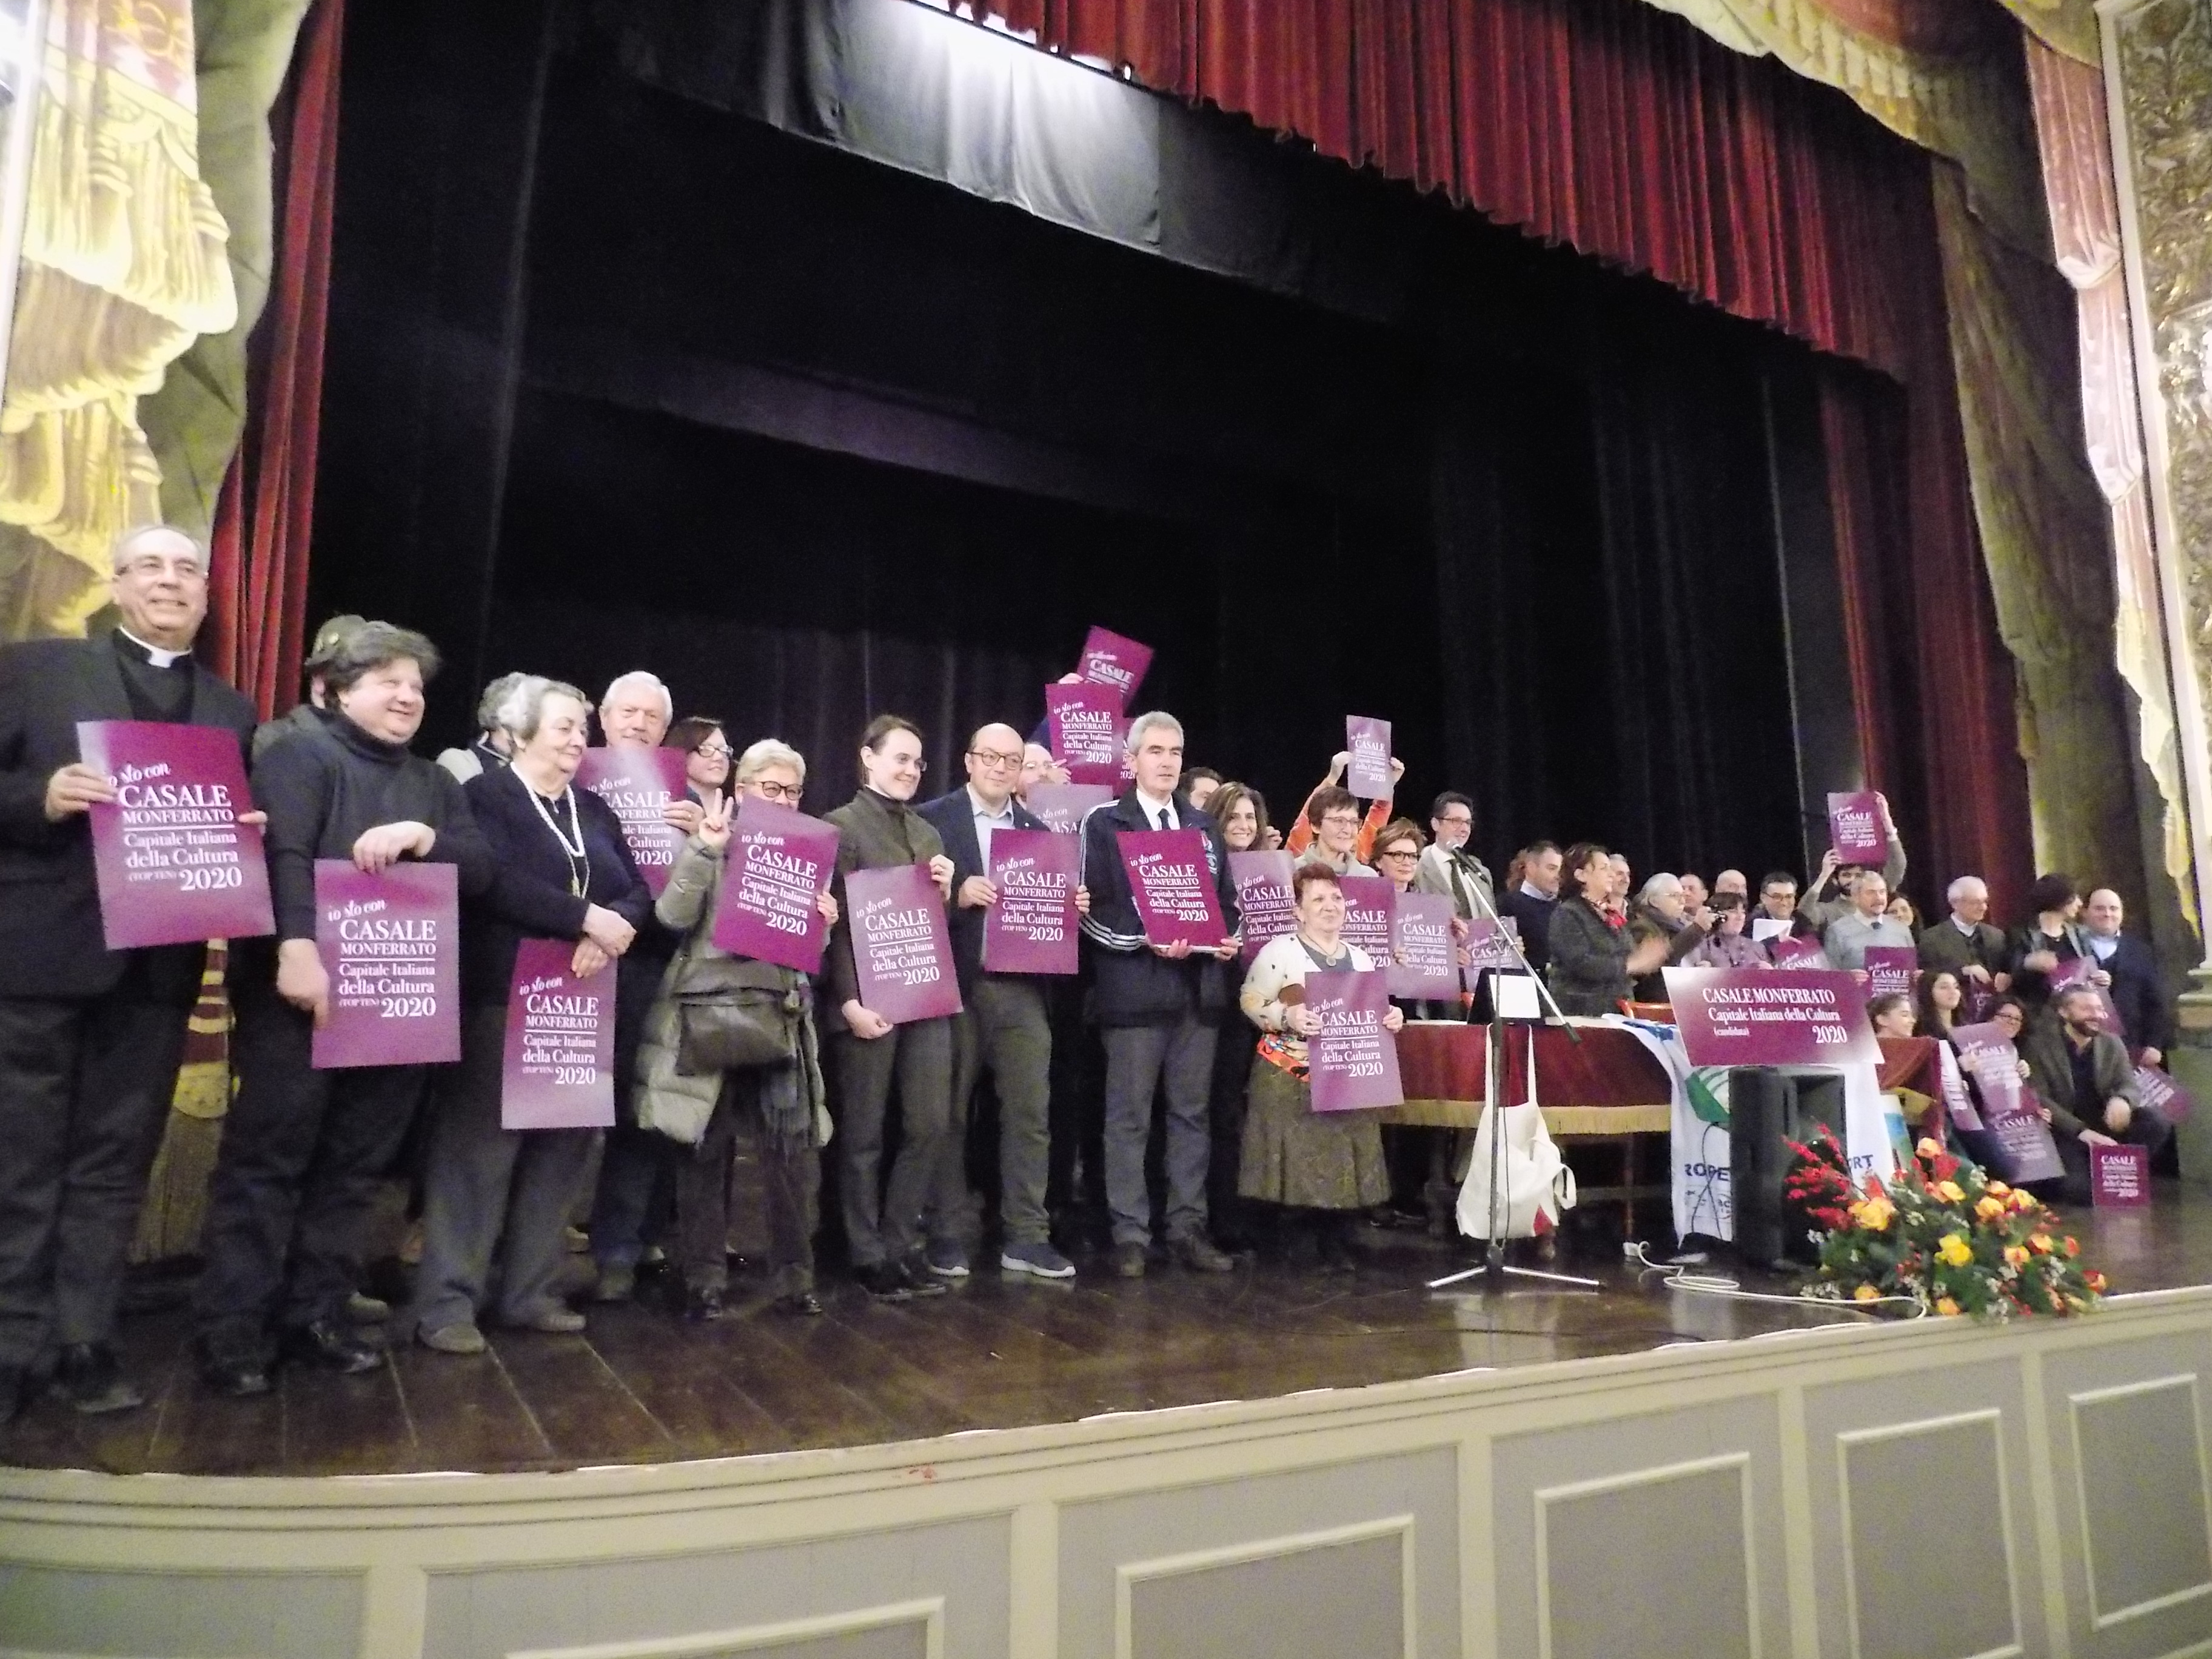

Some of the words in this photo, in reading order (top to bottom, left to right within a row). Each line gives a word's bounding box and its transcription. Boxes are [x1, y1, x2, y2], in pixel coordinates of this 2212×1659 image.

[1062, 702, 1071, 711] sto
[1061, 711, 1111, 723] CASALE
[1062, 733, 1089, 742] Capitale
[1084, 740, 1111, 751] Cultura
[1355, 740, 1385, 752] CASALE
[1086, 751, 1112, 763] 2020
[121, 763, 142, 783] sto
[144, 763, 172, 779] con
[1369, 773, 1386, 782] 2020
[600, 778, 612, 790] sto
[614, 777, 631, 787] con
[119, 785, 232, 808] CASALE
[123, 809, 234, 824] MONFERRATO
[1043, 809, 1053, 818] sto
[638, 825, 672, 834] Italiana
[124, 832, 184, 851] Capitale
[187, 830, 238, 845] Italiana
[627, 836, 671, 847] Cultura
[741, 830, 752, 843] io
[753, 831, 766, 844] sto
[767, 836, 785, 846] con
[126, 853, 170, 868] della
[173, 848, 239, 865] Cultura
[631, 851, 672, 865] 2020
[748, 845, 817, 879] CASALE
[996, 860, 1005, 872] io
[1007, 857, 1018, 870] sto
[1019, 857, 1036, 867] con
[1129, 857, 1138, 866] io
[1138, 854, 1148, 864] sto
[1150, 853, 1163, 862] con
[745, 861, 815, 890] MONFERRATO
[1139, 865, 1198, 877] CASALE
[180, 867, 243, 891] 2020
[1004, 871, 1066, 888] CASALE
[1244, 877, 1253, 887] sto
[1253, 875, 1264, 883] con
[742, 877, 778, 895] Capitale
[780, 888, 811, 905] Italiana
[1004, 886, 1065, 898] MONFERRATO
[1146, 890, 1175, 899] Capitale
[1243, 885, 1293, 902] CASALE
[328, 905, 341, 921] io
[344, 900, 362, 917] sto
[363, 900, 386, 913] con
[739, 889, 765, 906] della
[768, 895, 808, 919] Cultura
[857, 906, 865, 918] io
[865, 900, 877, 914] sto
[878, 897, 892, 908] con
[1002, 901, 1034, 913] Capitale
[1036, 904, 1064, 913] Italiana
[1150, 899, 1170, 907] della
[1171, 899, 1205, 908] Cultura
[1244, 899, 1294, 910] MONFERRATO
[766, 911, 807, 936] 2020
[865, 908, 930, 931] CASALE
[1002, 913, 1025, 923] della
[1027, 913, 1063, 925] Cultura
[1176, 910, 1208, 922] 2020
[1245, 914, 1272, 924] Capitale
[1344, 911, 1387, 923] ASALE
[340, 919, 437, 940] CASALE
[867, 926, 931, 943] MONFERRATO
[1028, 927, 1064, 941] 2020
[1247, 925, 1266, 935] della
[1267, 923, 1298, 933] Cultura
[1403, 923, 1446, 936] CASALE
[341, 942, 437, 955] MONFERRATO
[870, 945, 904, 960] Capitale
[905, 943, 934, 953] Italiana
[873, 959, 897, 972] della
[898, 956, 937, 968] Cultura
[1421, 955, 1447, 964] Cultura
[339, 963, 390, 979] Capitale
[393, 963, 435, 975] Italiana
[903, 966, 940, 985] 2020
[1423, 965, 1448, 976] 2020
[1872, 970, 1909, 978] CASALE
[339, 980, 375, 994] della
[378, 979, 435, 994] Cultura
[520, 980, 529, 995] io
[532, 976, 545, 992] sto
[546, 976, 563, 988] con
[1703, 988, 1754, 1003] CASALE
[1752, 988, 1835, 1004] MONFERRATO
[381, 997, 437, 1018] 2020
[526, 994, 599, 1016] CASALE
[1313, 1003, 1320, 1013] io
[1321, 999, 1330, 1011] sto
[1332, 998, 1342, 1008] con
[526, 1016, 597, 1028] MONFERRATO
[1320, 1010, 1377, 1026] CASALE
[1708, 1007, 1749, 1025] Capitale
[1749, 1007, 1784, 1021] Italiana
[1784, 1007, 1806, 1021] della
[1806, 1007, 1841, 1021] Cultura
[1320, 1026, 1378, 1036] MONFERRATO
[1812, 1025, 1847, 1044] 2020
[523, 1034, 562, 1049] Capitale
[563, 1036, 596, 1048] Italiana
[1321, 1042, 1350, 1053] Capitale
[523, 1049, 551, 1063] della
[552, 1049, 595, 1064] Cultura
[1322, 1053, 1343, 1063] della
[1344, 1050, 1381, 1062] Cultura
[555, 1066, 596, 1084] 2020
[1348, 1062, 1384, 1077] 2020
[2101, 1155, 2136, 1164] CASALE
